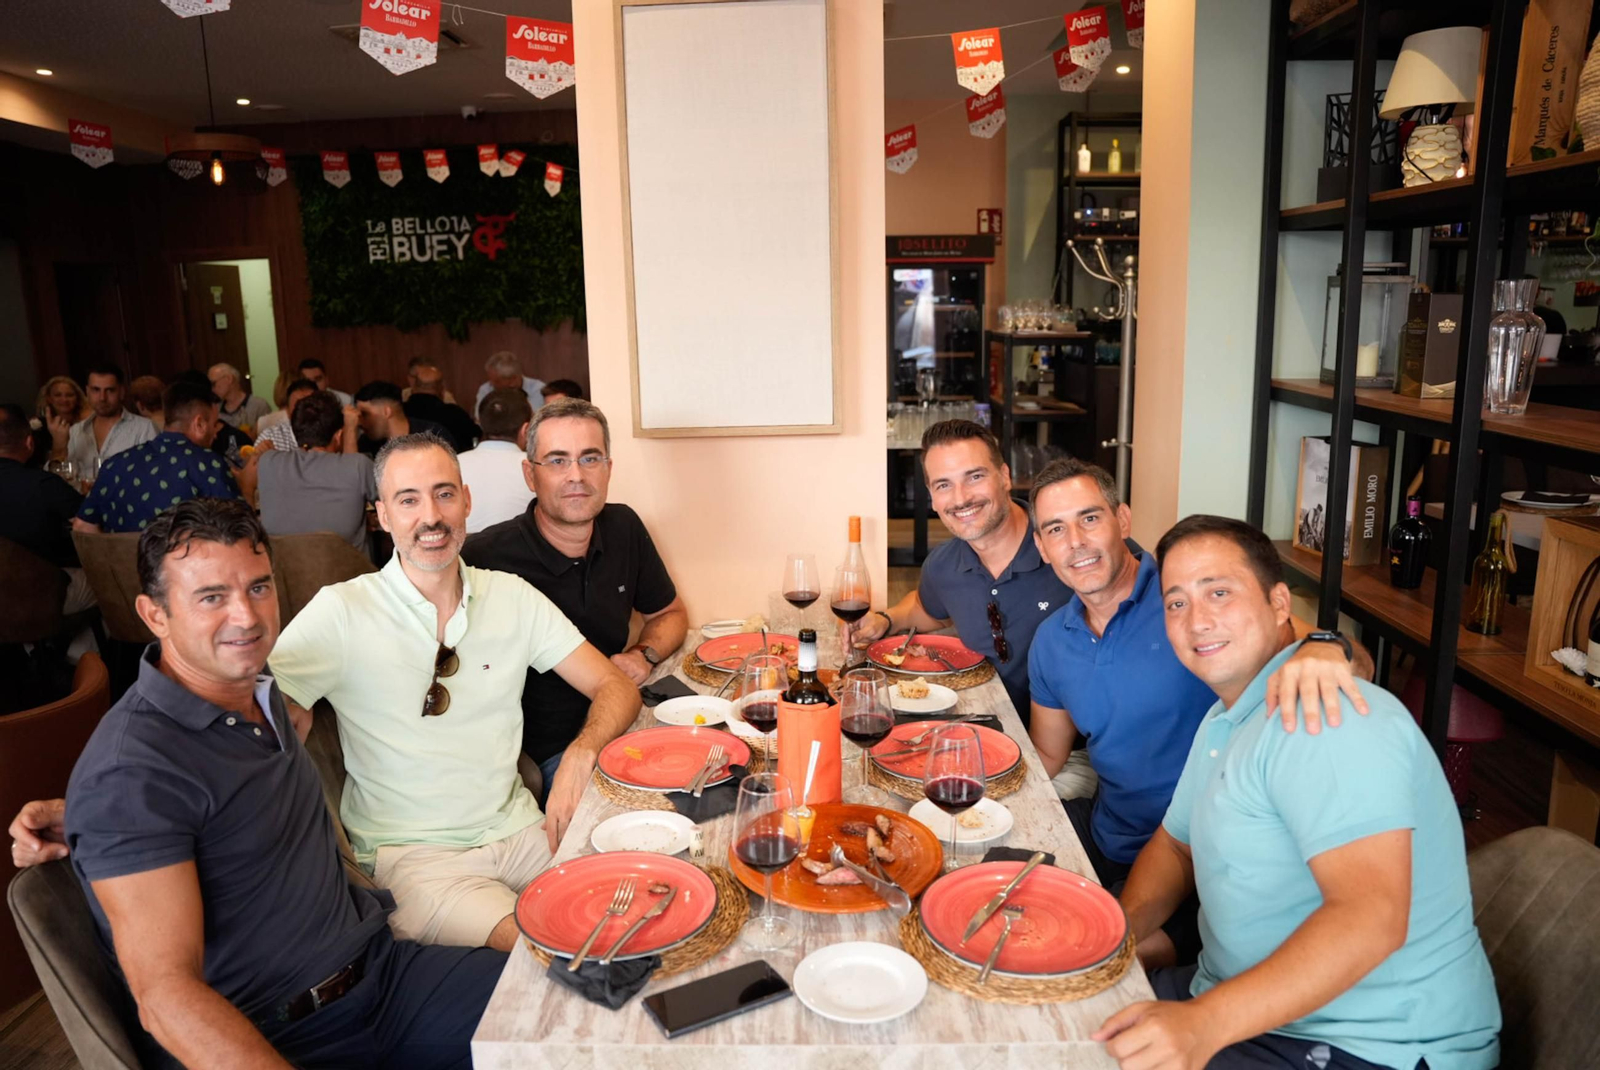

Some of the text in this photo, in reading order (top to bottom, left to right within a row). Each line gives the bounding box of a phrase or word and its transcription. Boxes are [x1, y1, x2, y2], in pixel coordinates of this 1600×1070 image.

[369, 0, 431, 20] Solear
[1069, 15, 1102, 32] Solear
[512, 24, 568, 45] Solear
[958, 36, 995, 52] Solear
[1534, 25, 1559, 146] Marqués de Cáceres
[73, 124, 106, 138] Solear
[887, 131, 913, 147] Solear
[391, 215, 472, 235] BELLOTA
[392, 233, 471, 263] BUEY
[1364, 475, 1378, 538] EMILIO MORO
